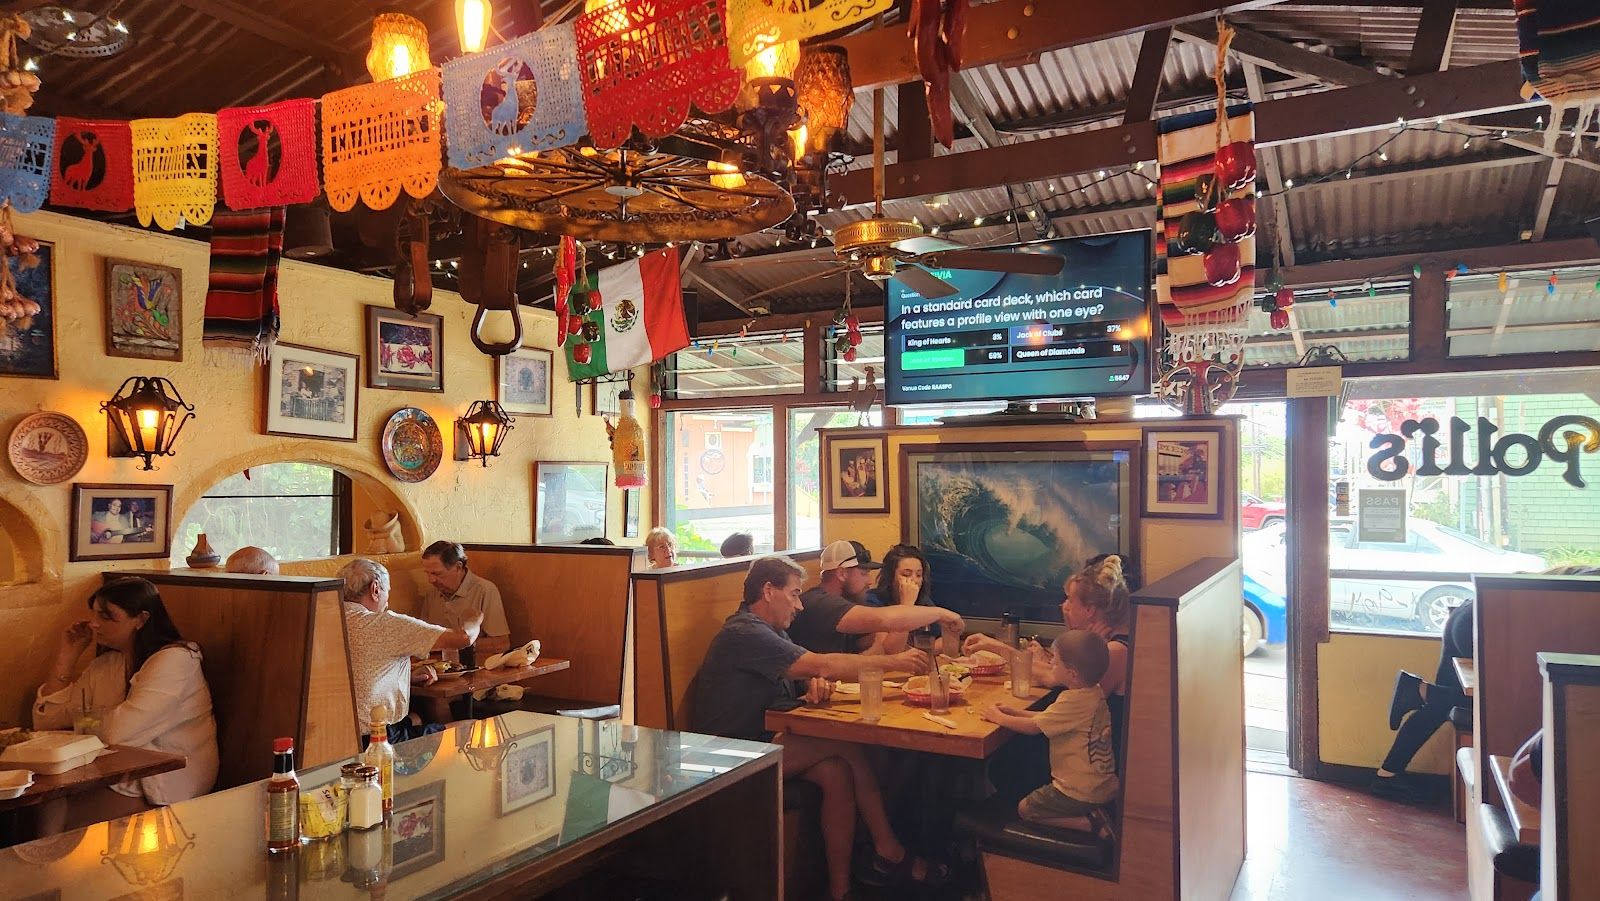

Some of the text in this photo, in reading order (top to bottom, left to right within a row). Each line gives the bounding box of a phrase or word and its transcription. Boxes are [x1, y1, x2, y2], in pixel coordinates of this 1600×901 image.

[901, 287, 1102, 315] In a standard card deck, which card
[901, 304, 1105, 330] features a profile view with one eye?
[1016, 332, 1033, 340] Jack
[1042, 328, 1064, 337] Clubs
[1106, 324, 1121, 332] 37%
[907, 336, 952, 347] King of Hearts
[1016, 350, 1040, 358] Queen
[1048, 346, 1086, 356] Diamonds
[1112, 344, 1122, 352] 1%
